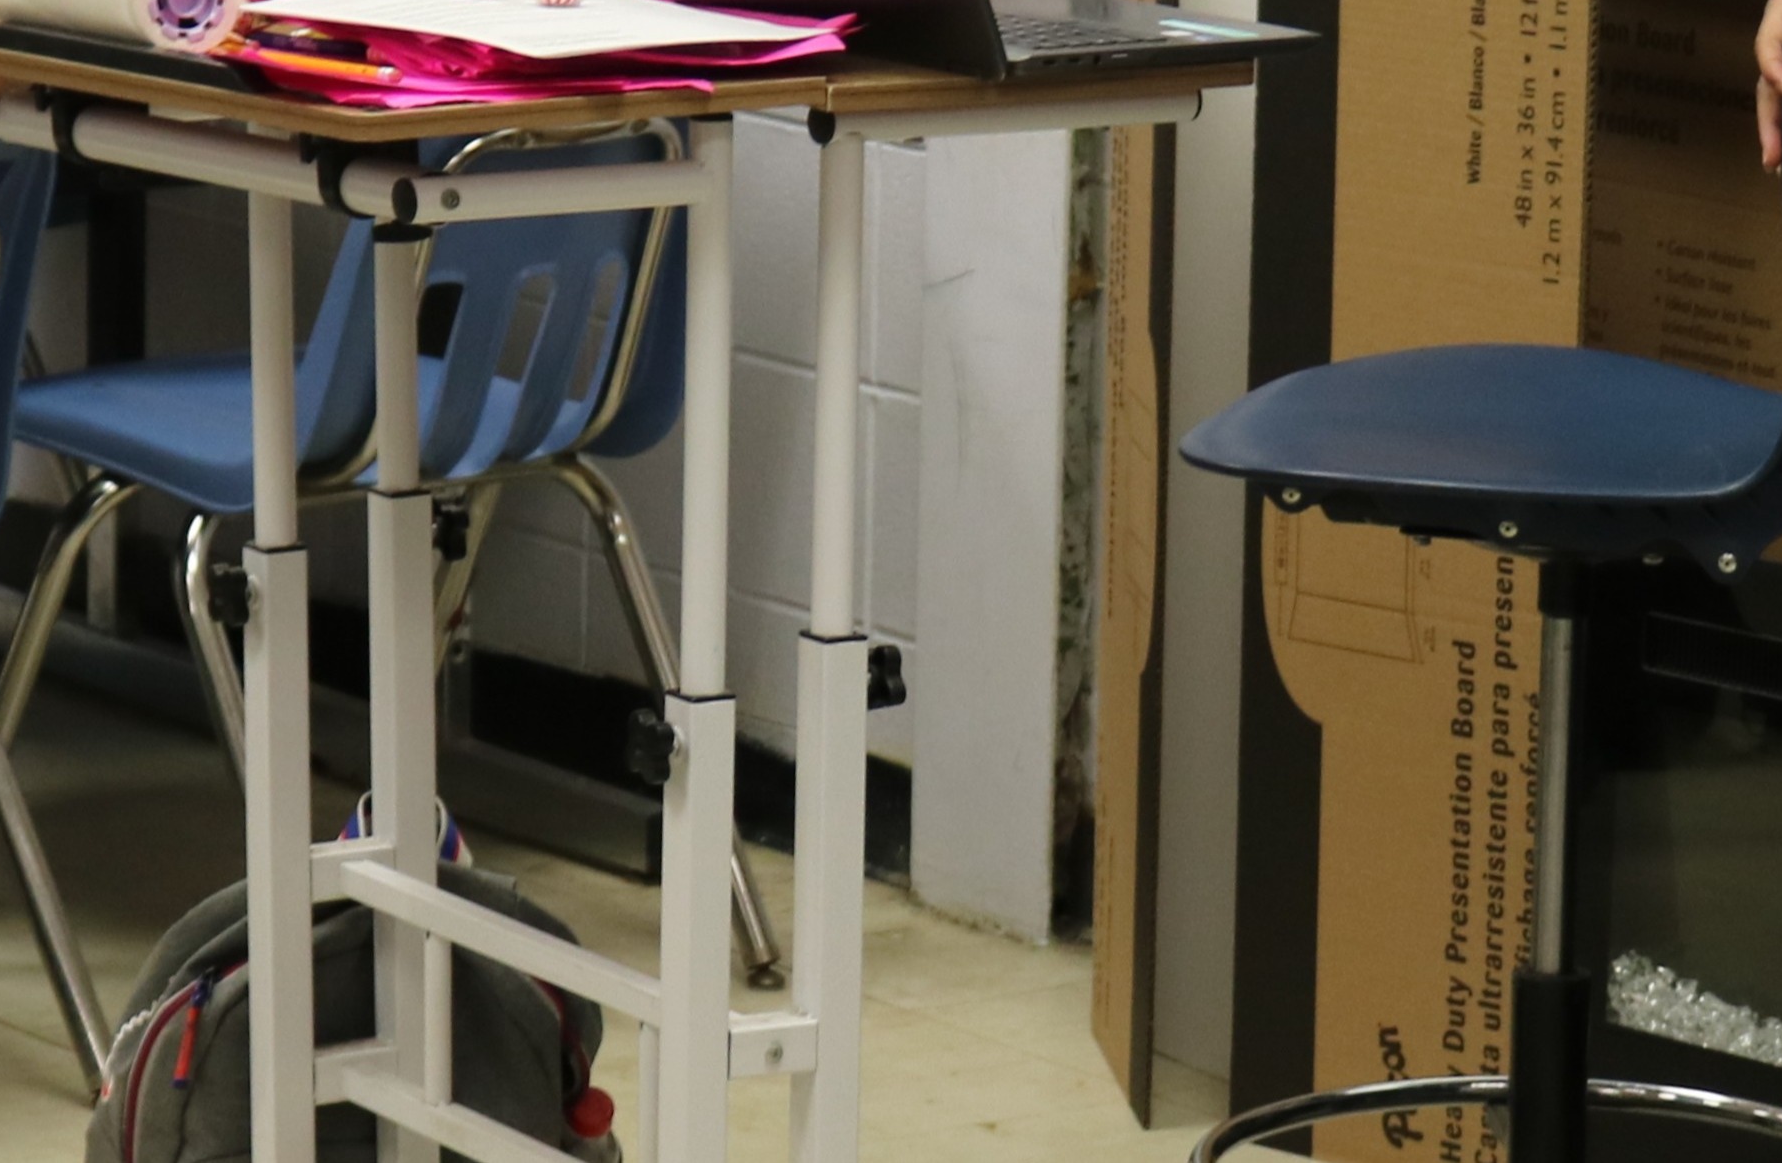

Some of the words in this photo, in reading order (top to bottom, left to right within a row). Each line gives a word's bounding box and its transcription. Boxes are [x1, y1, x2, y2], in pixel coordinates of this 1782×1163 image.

[1520, 12, 1538, 37] 12
[1549, 26, 1567, 51] 1.1
[1469, 46, 1485, 110] Blanco
[1517, 105, 1535, 135] 36
[1466, 131, 1482, 184] White
[1521, 146, 1533, 160] x
[1545, 136, 1564, 185] 91.4
[1514, 196, 1532, 228] 48
[1549, 195, 1562, 209] x
[1548, 218, 1562, 243] m
[1542, 253, 1561, 285] 1.2
[1450, 639, 1475, 738] Board
[1493, 683, 1515, 758] para
[1445, 753, 1474, 964] Presentation
[1478, 770, 1509, 1032] ultrarresistente
[1443, 976, 1473, 1053] Duty
[1377, 1026, 1425, 1150] Pcon
[1440, 1065, 1467, 1163] Heay
